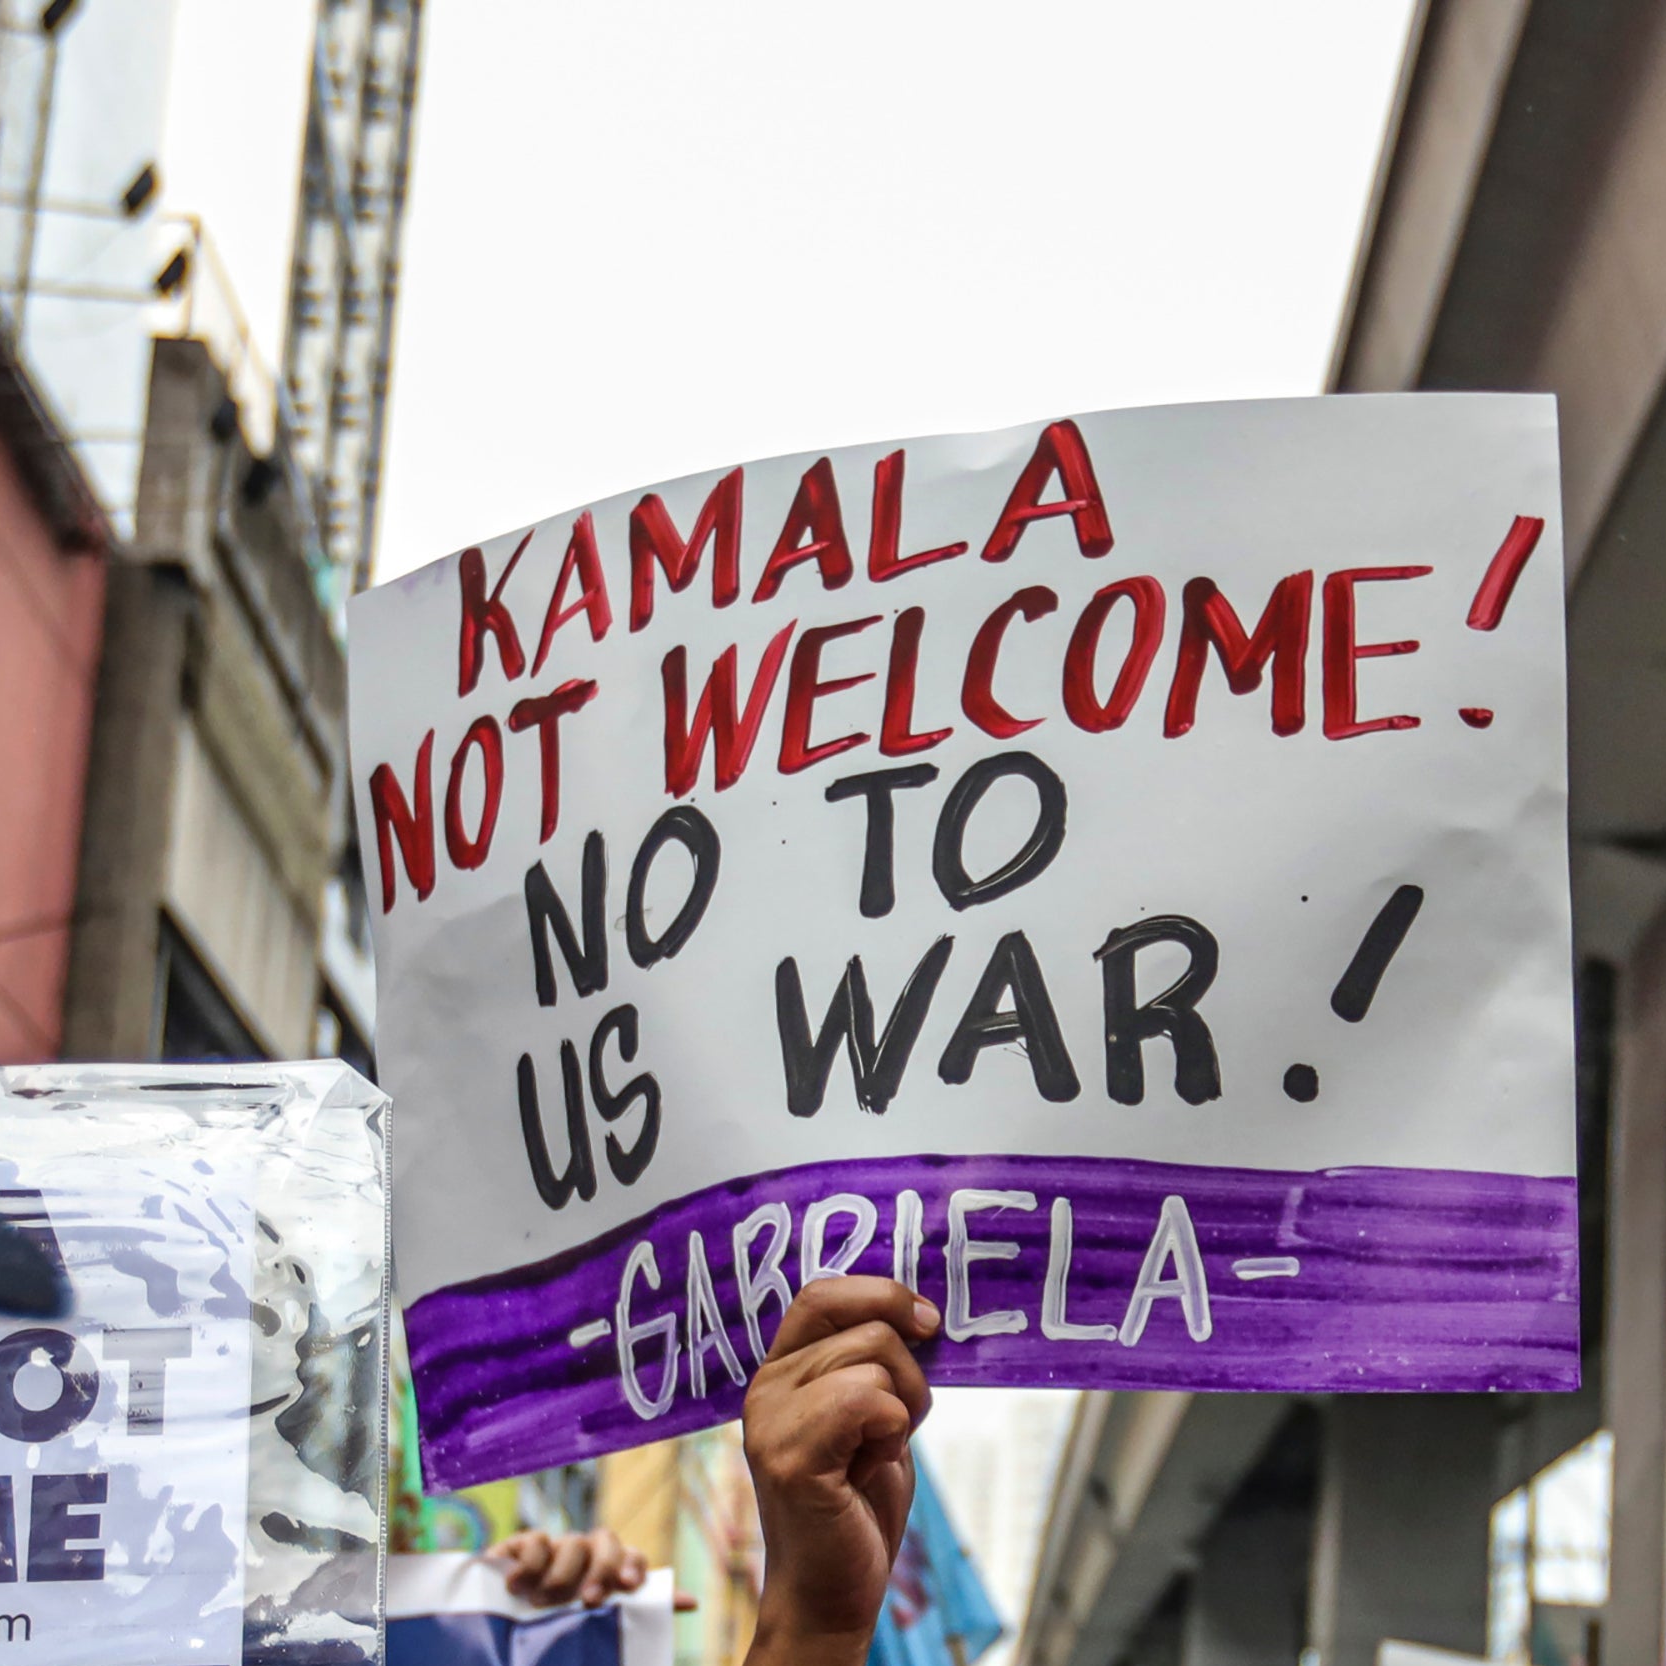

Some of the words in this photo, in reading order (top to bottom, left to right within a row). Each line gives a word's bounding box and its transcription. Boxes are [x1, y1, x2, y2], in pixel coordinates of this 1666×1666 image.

[457, 420, 1115, 697] KAMALA
[369, 679, 599, 914] NOT
[662, 515, 1545, 799] WELCOME!
[523, 804, 722, 1008] NO
[824, 750, 1069, 919] TO
[515, 1002, 663, 1213] US
